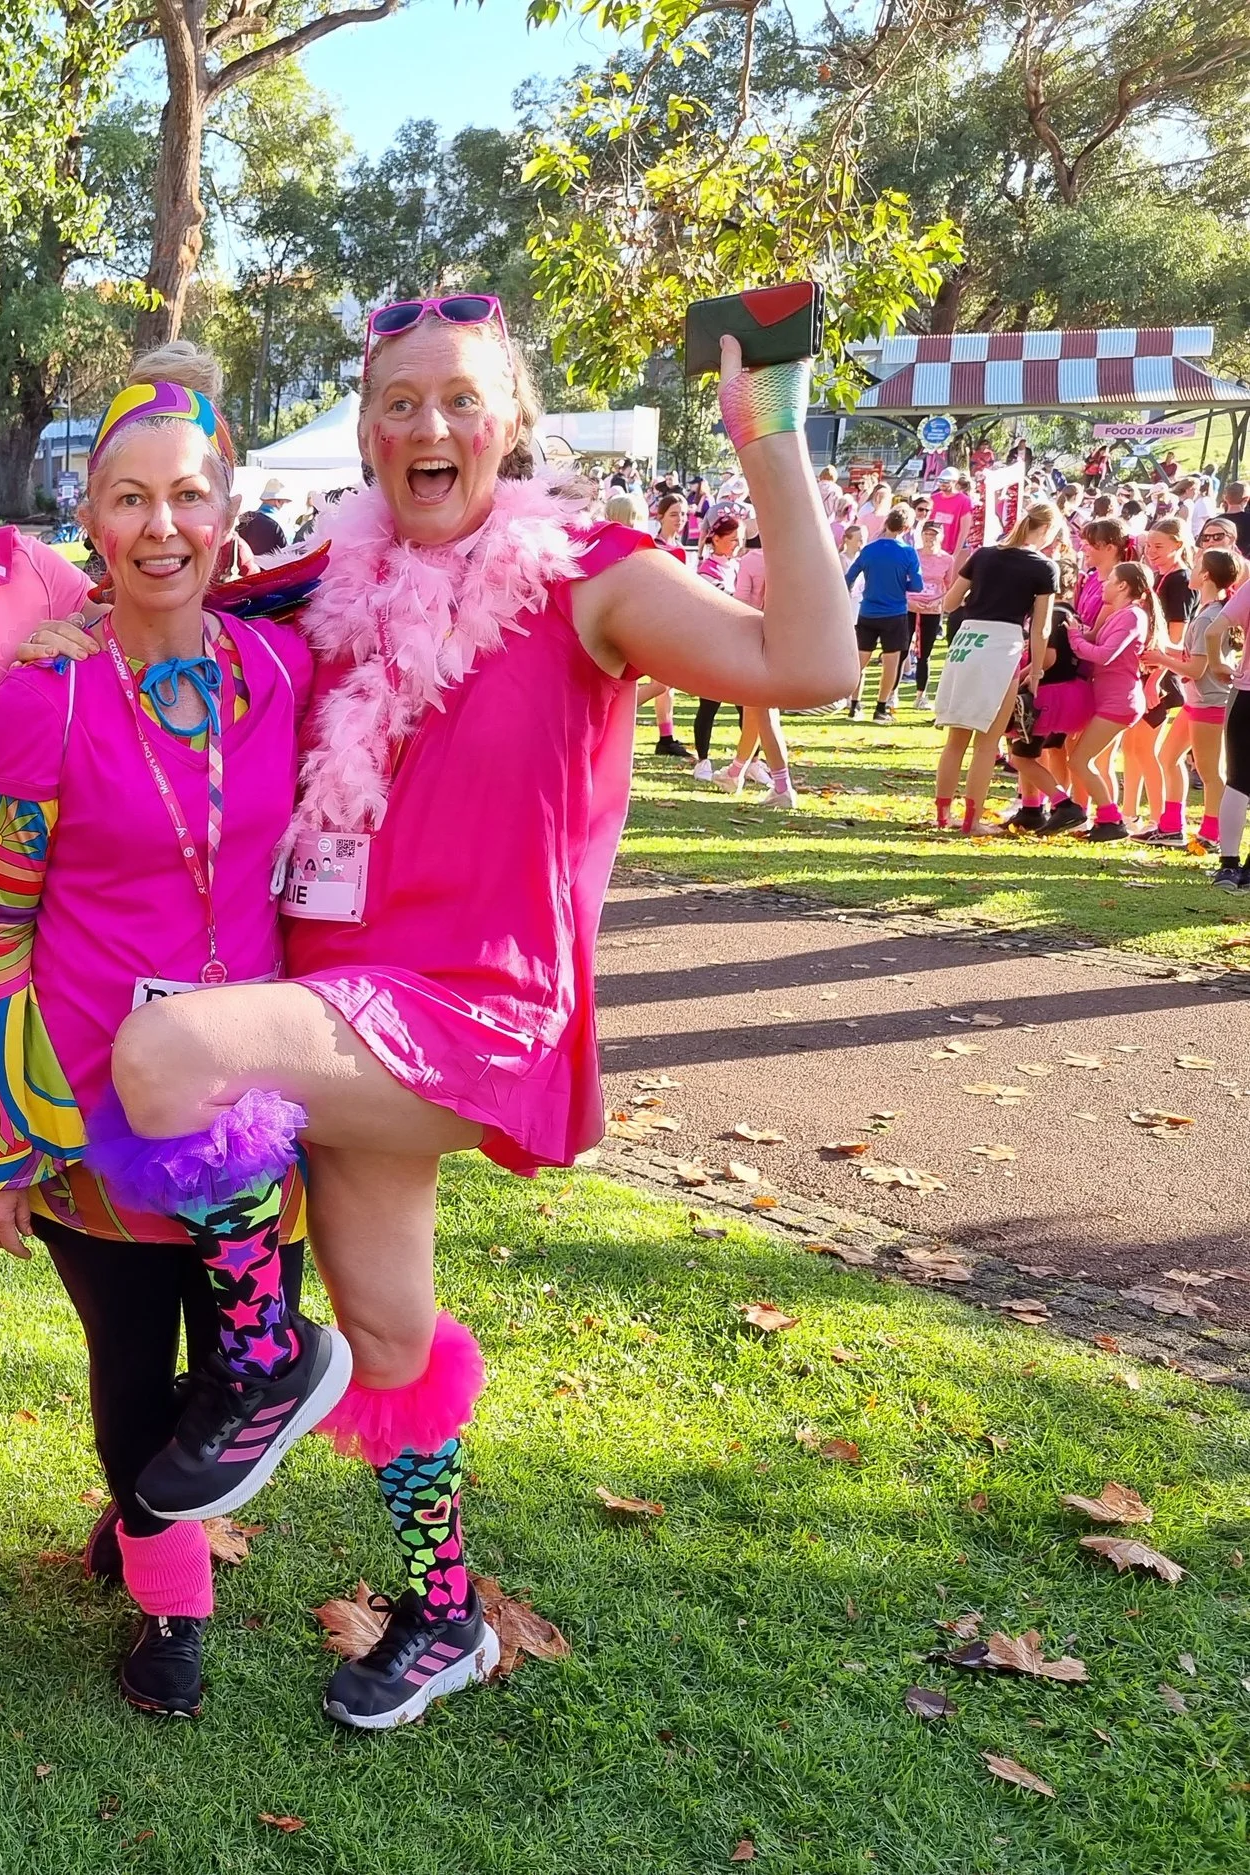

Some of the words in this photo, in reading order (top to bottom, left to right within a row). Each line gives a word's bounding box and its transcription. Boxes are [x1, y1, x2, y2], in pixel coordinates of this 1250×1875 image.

[1105, 427, 1135, 435] FOOD
[1144, 426, 1184, 435] DRINKS
[107, 638, 130, 681] #MDC2023
[142, 741, 153, 759] Day
[150, 758, 170, 795] Mother's
